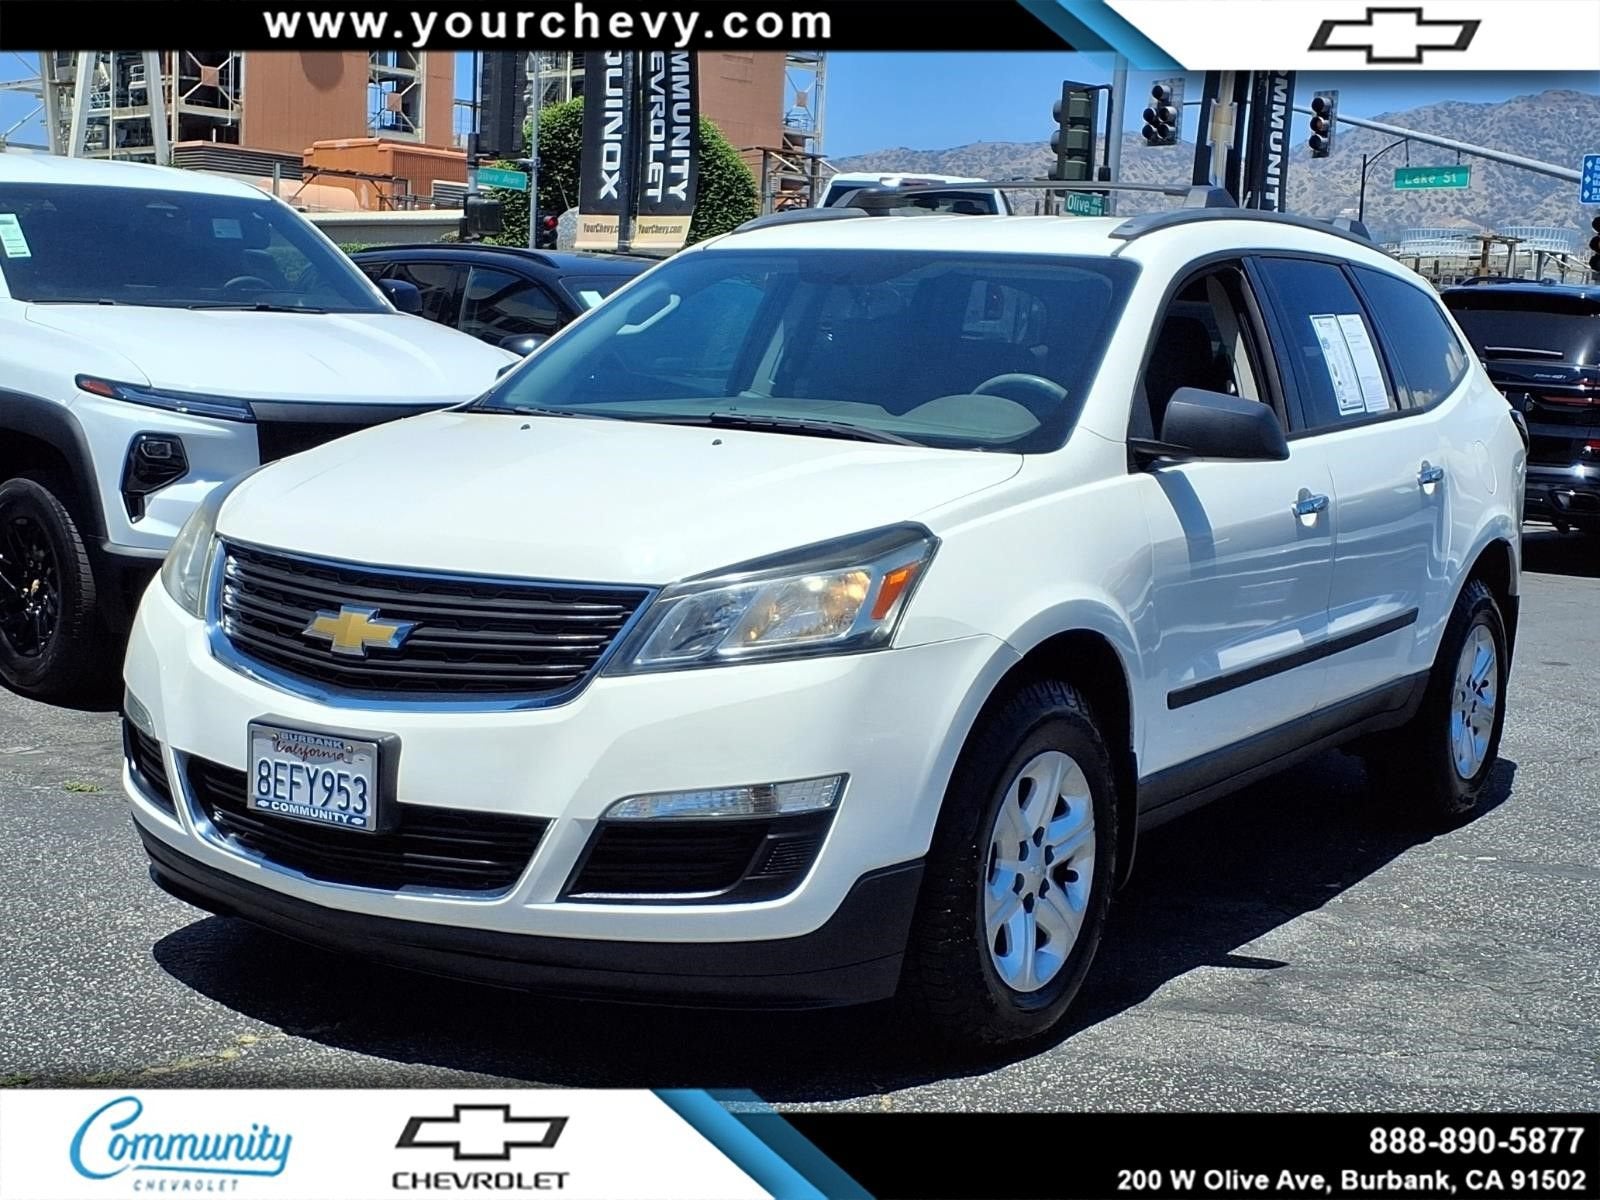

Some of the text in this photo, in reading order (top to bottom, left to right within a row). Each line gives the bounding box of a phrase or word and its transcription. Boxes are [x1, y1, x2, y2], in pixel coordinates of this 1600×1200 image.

[1265, 70, 1289, 213] MMUNIT
[1067, 194, 1090, 213] Olive
[278, 731, 344, 749] BURBANK
[257, 759, 368, 815] 8EFY953
[271, 801, 350, 825] COMMUNITY
